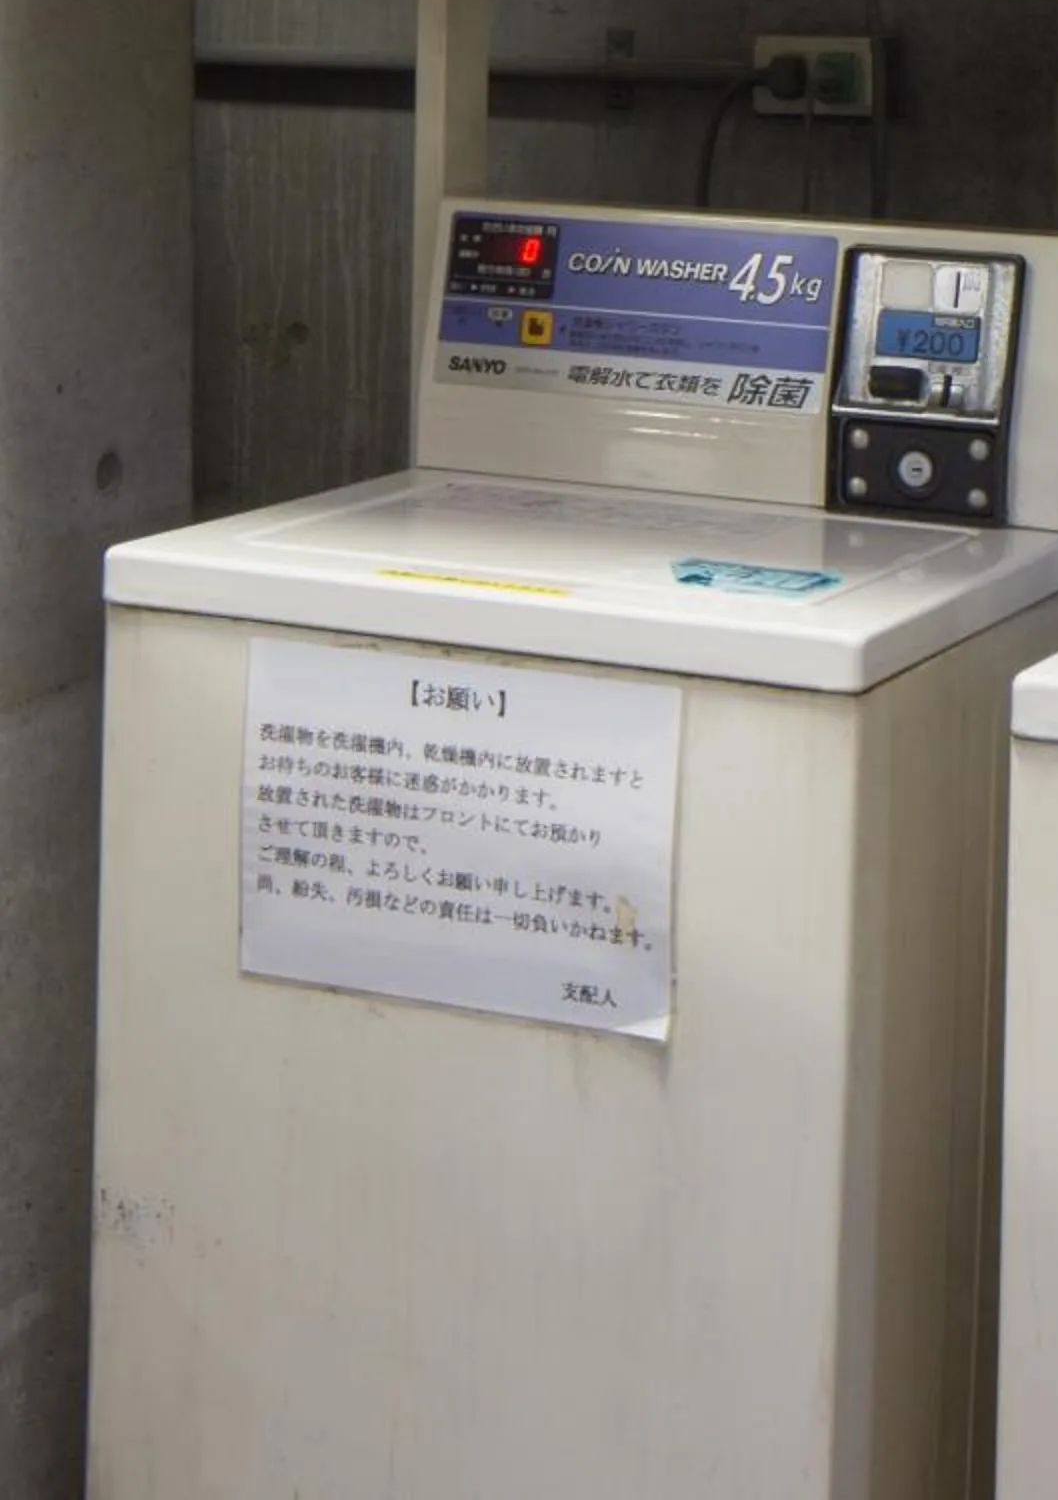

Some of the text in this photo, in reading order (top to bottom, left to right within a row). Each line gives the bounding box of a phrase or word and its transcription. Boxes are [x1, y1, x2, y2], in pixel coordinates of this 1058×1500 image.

[523, 238, 541, 263] 0
[637, 258, 728, 283] WASHER
[896, 328, 965, 358] ¥200
[448, 355, 508, 376] SANYO
[728, 372, 815, 410] 除菌
[407, 679, 507, 718] 【お願い】
[561, 982, 618, 1009] 支配人
